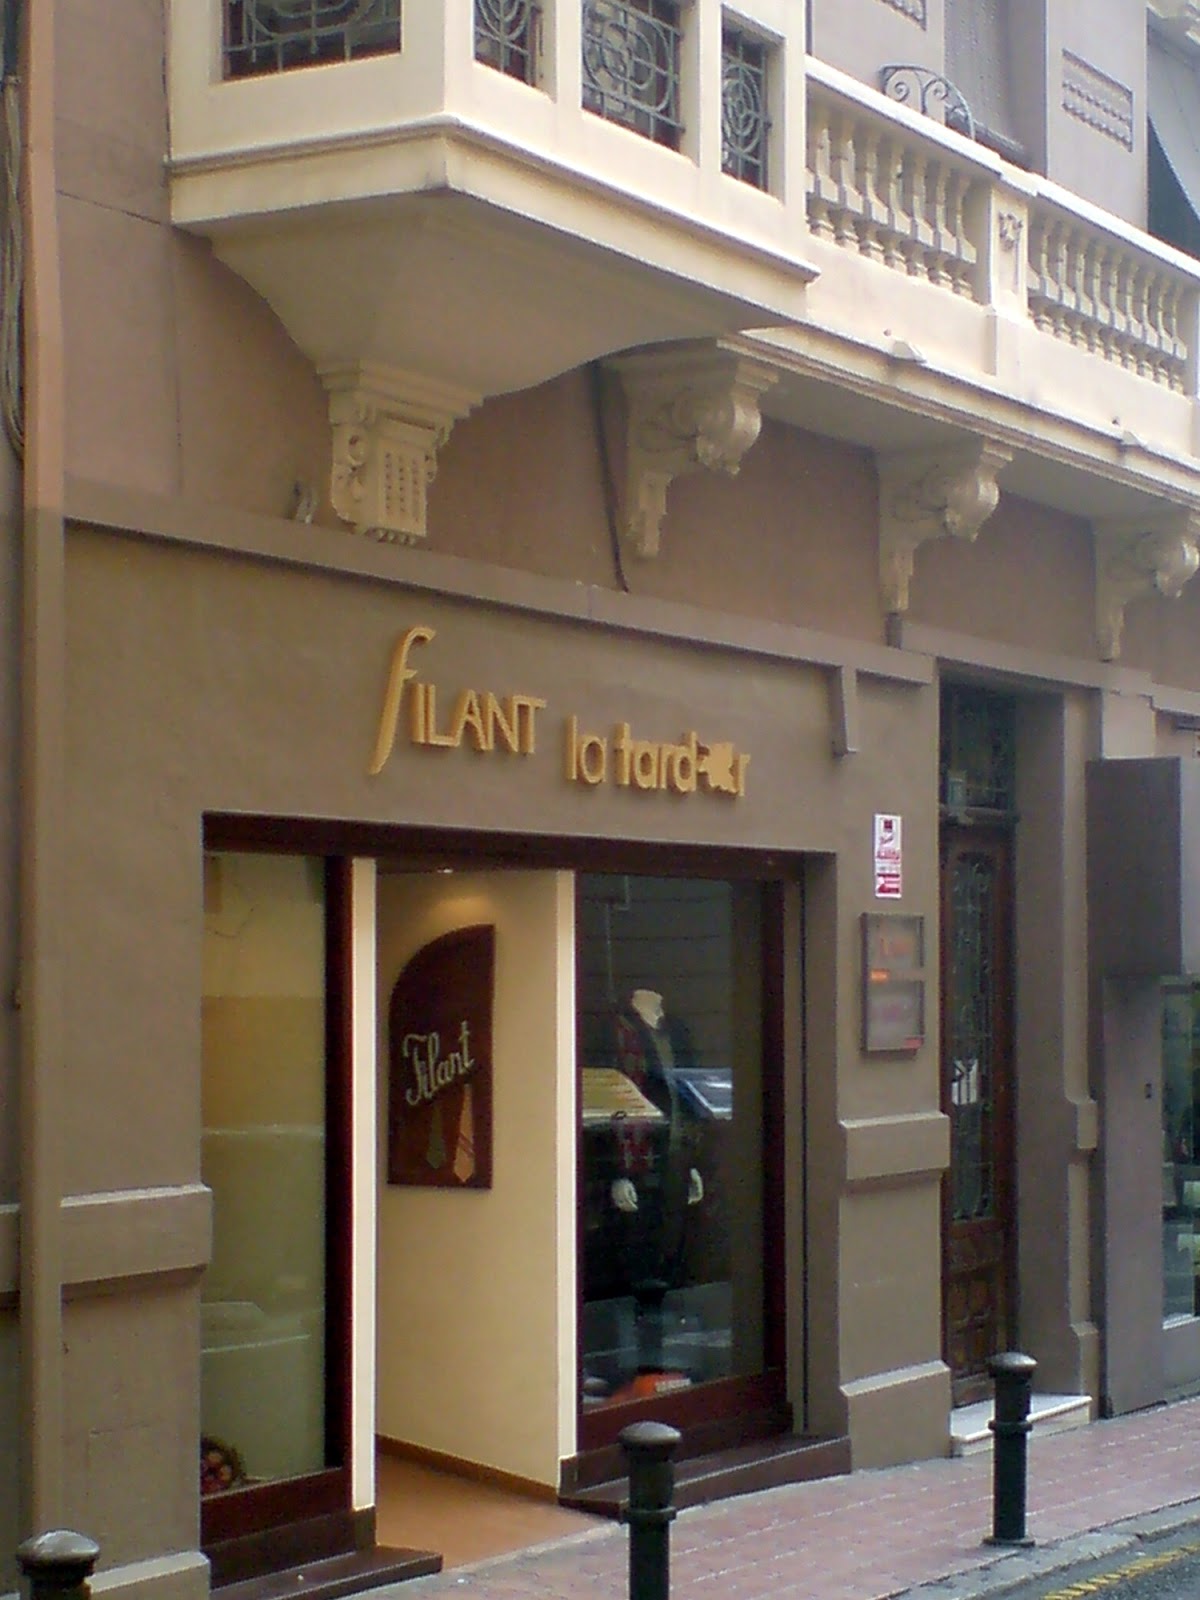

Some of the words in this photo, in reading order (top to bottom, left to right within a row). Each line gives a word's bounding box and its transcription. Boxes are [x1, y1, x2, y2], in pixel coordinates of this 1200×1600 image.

[564, 714, 607, 784] la
[614, 721, 750, 797] tardr
[403, 1020, 475, 1106] Filant
